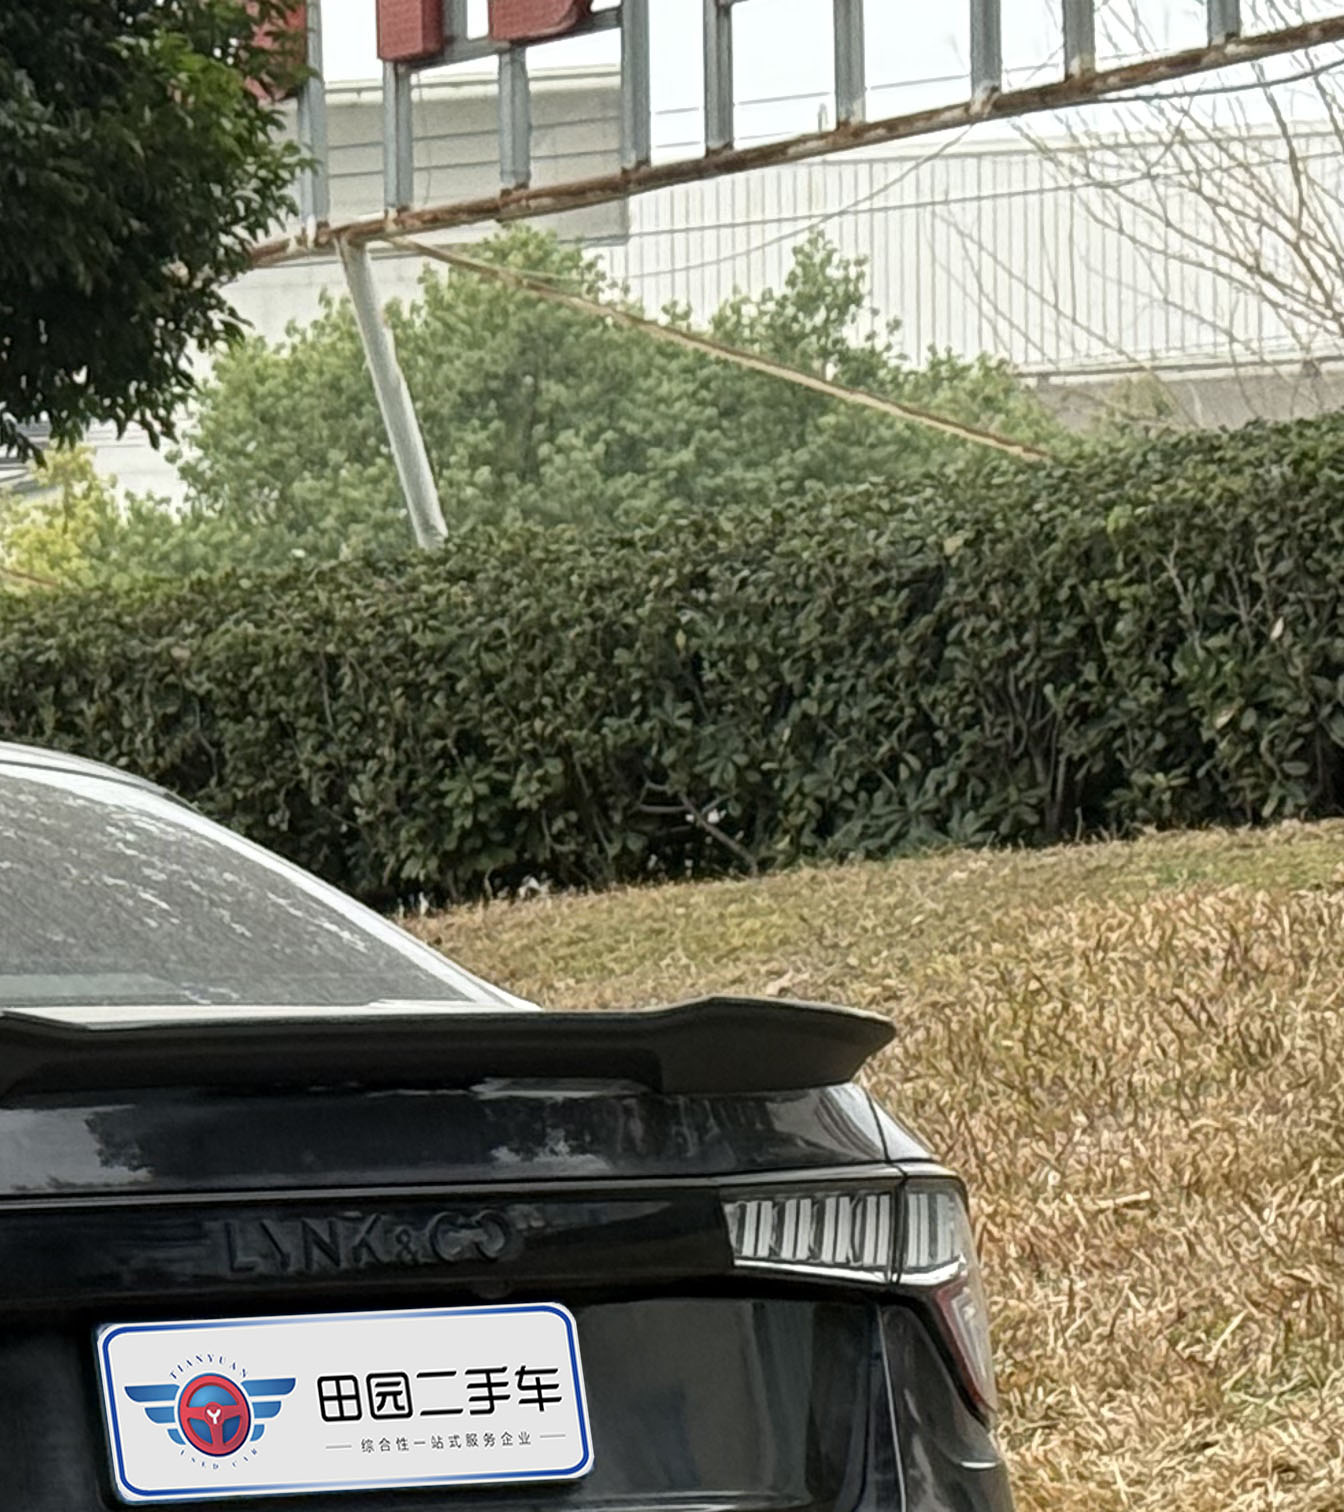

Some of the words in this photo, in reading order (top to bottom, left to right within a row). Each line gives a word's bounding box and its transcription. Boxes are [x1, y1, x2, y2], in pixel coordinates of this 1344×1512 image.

[317, 1365, 563, 1422] 田园二手车
[360, 1432, 532, 1453] 综合性一站式服务企业
